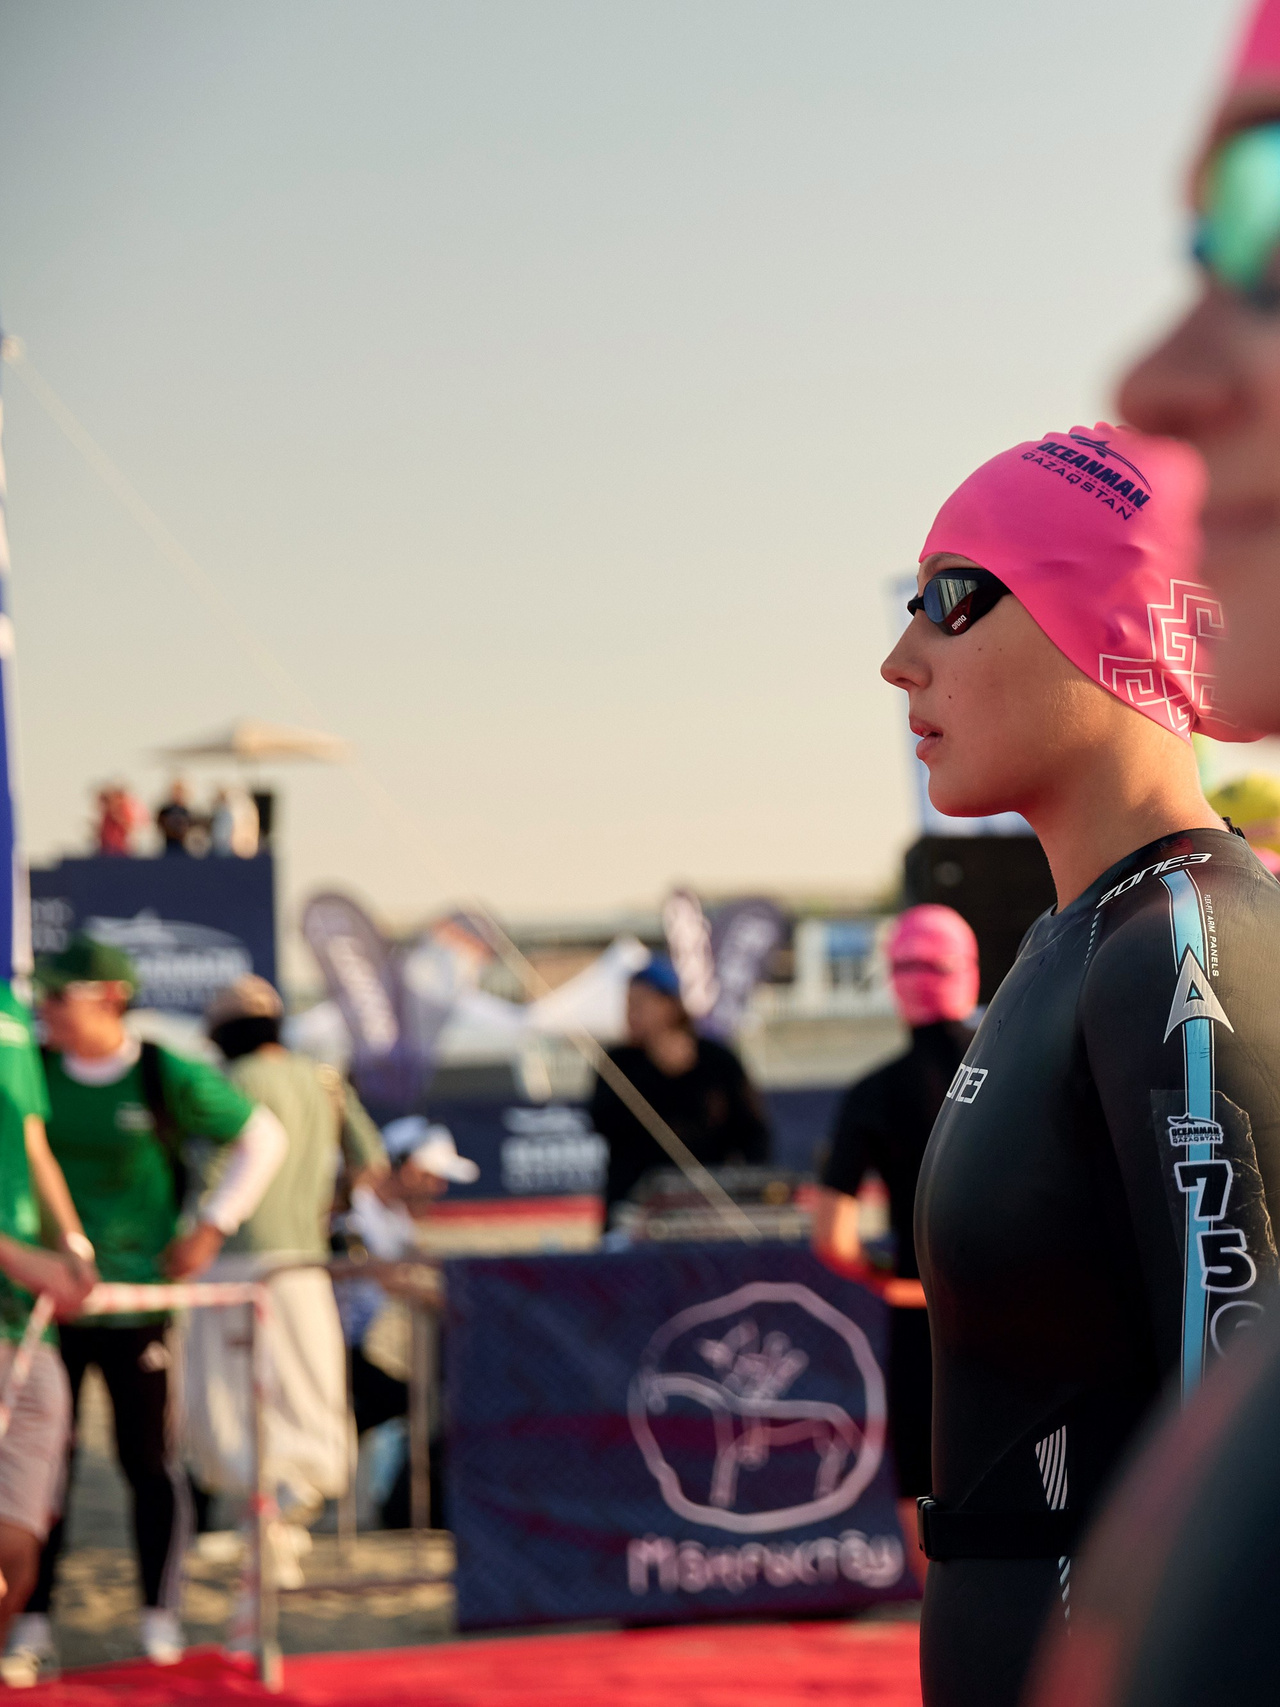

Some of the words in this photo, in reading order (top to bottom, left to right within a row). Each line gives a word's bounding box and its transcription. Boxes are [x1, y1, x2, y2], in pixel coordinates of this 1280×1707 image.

[1021, 452, 1132, 520] QAZAQSTAN
[1036, 442, 1150, 509] OCEANMAN
[951, 614, 967, 630] arena
[1096, 853, 1212, 909] ZONE3
[1207, 915, 1216, 933] ARM
[1210, 935, 1219, 977] PANELS
[1171, 1126, 1219, 1136] OCEANMAN
